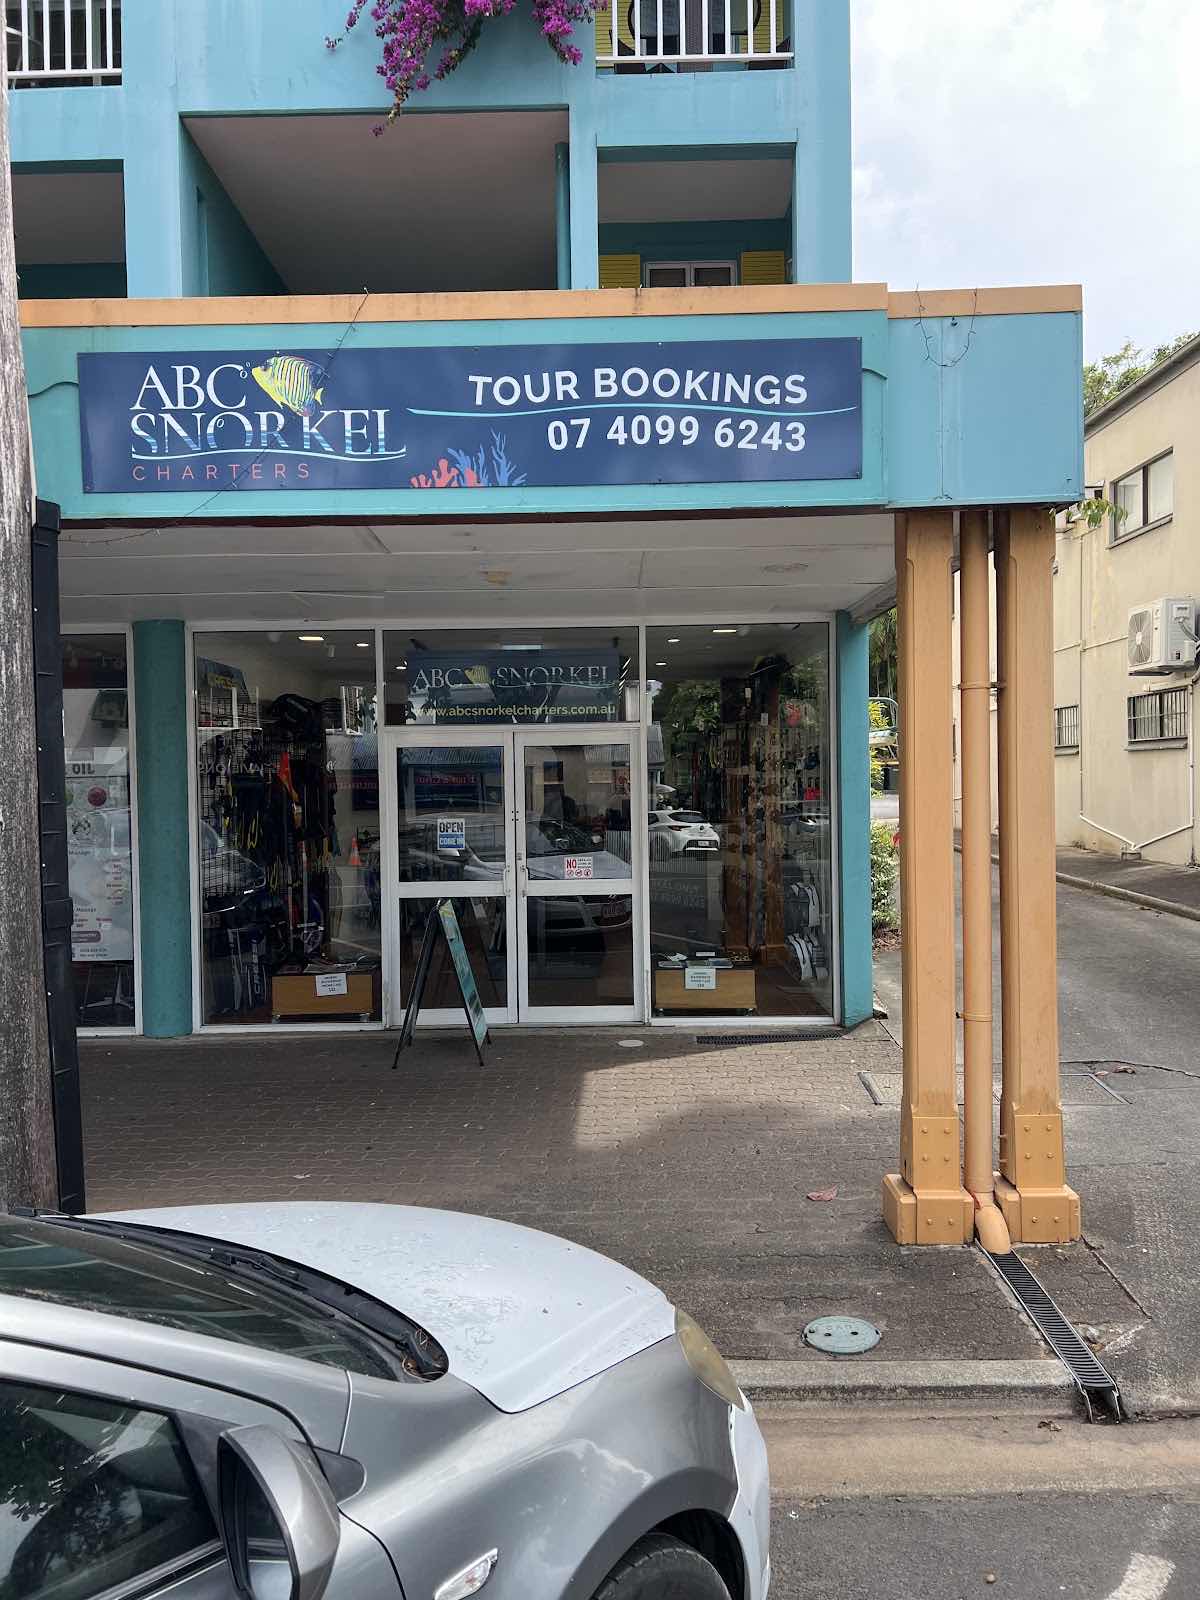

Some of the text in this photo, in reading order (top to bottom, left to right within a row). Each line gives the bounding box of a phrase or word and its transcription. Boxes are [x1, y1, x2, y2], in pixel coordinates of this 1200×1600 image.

[129, 363, 247, 410] ABC
[468, 366, 808, 406] TOUR BOOKINGS
[130, 408, 407, 455] SNORKEL
[547, 414, 807, 452] 07 4099 6243
[131, 462, 310, 482] CHARTERS
[412, 665, 609, 689] ABC SNORKEL
[416, 702, 616, 718] www.abcsnorkelcharters.com.au
[72, 763, 96, 775] OIL
[439, 821, 464, 833] OPEN
[566, 858, 577, 869] NO
